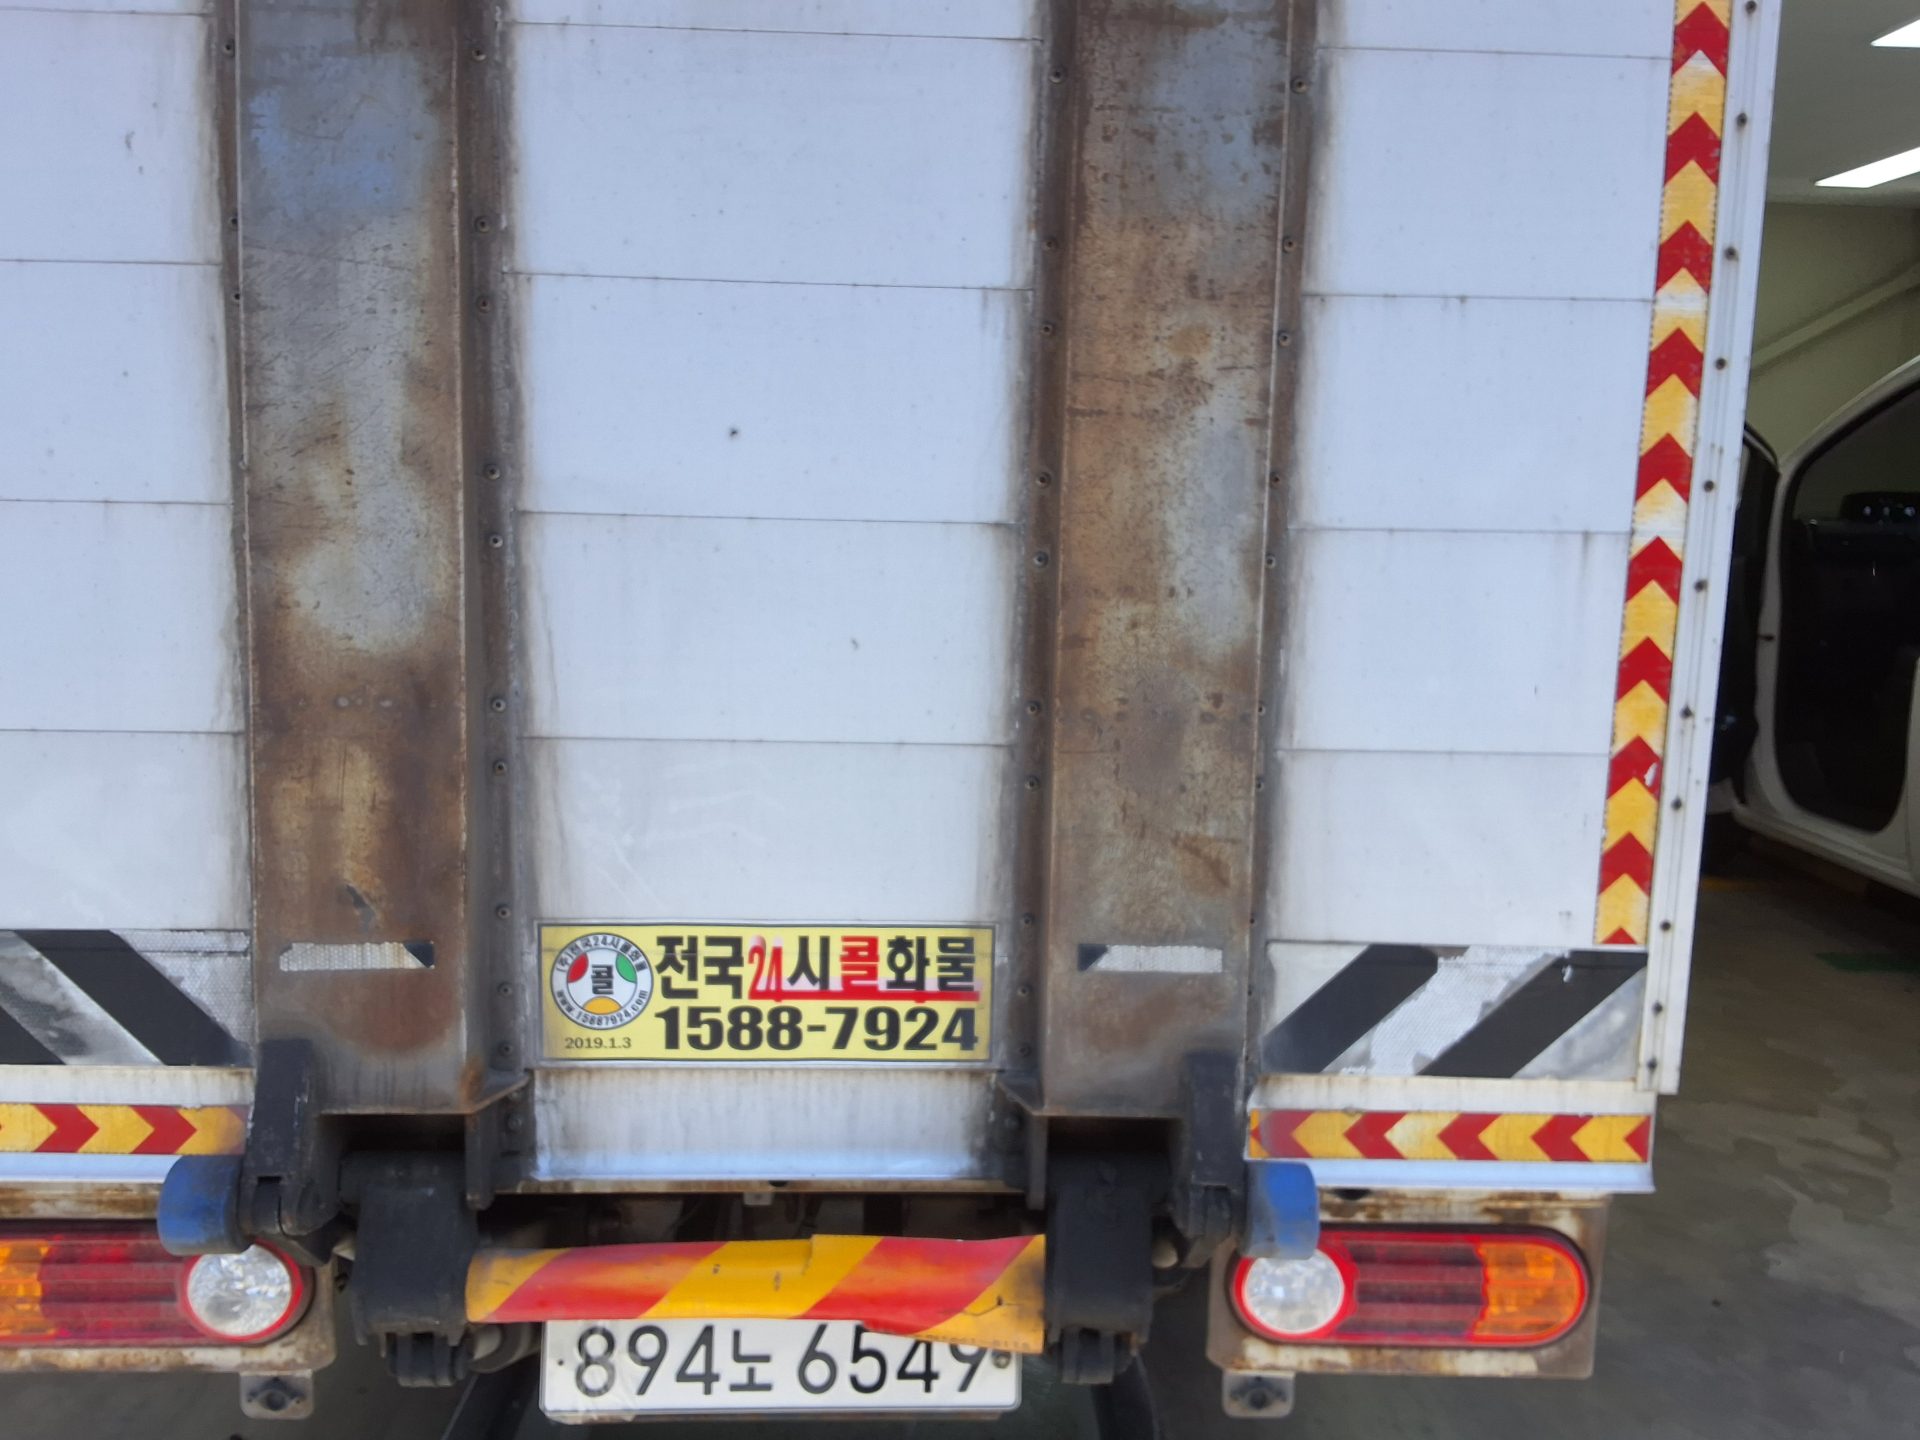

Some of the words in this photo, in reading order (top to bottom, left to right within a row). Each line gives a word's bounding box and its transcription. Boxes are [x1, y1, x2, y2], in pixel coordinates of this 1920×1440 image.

[591, 964, 614, 995] 콜
[564, 1036, 632, 1049] 2019.1.3
[655, 1005, 978, 1051] 1588-7924
[575, 1323, 773, 1396] 894노
[798, 1323, 990, 1394] 6549
